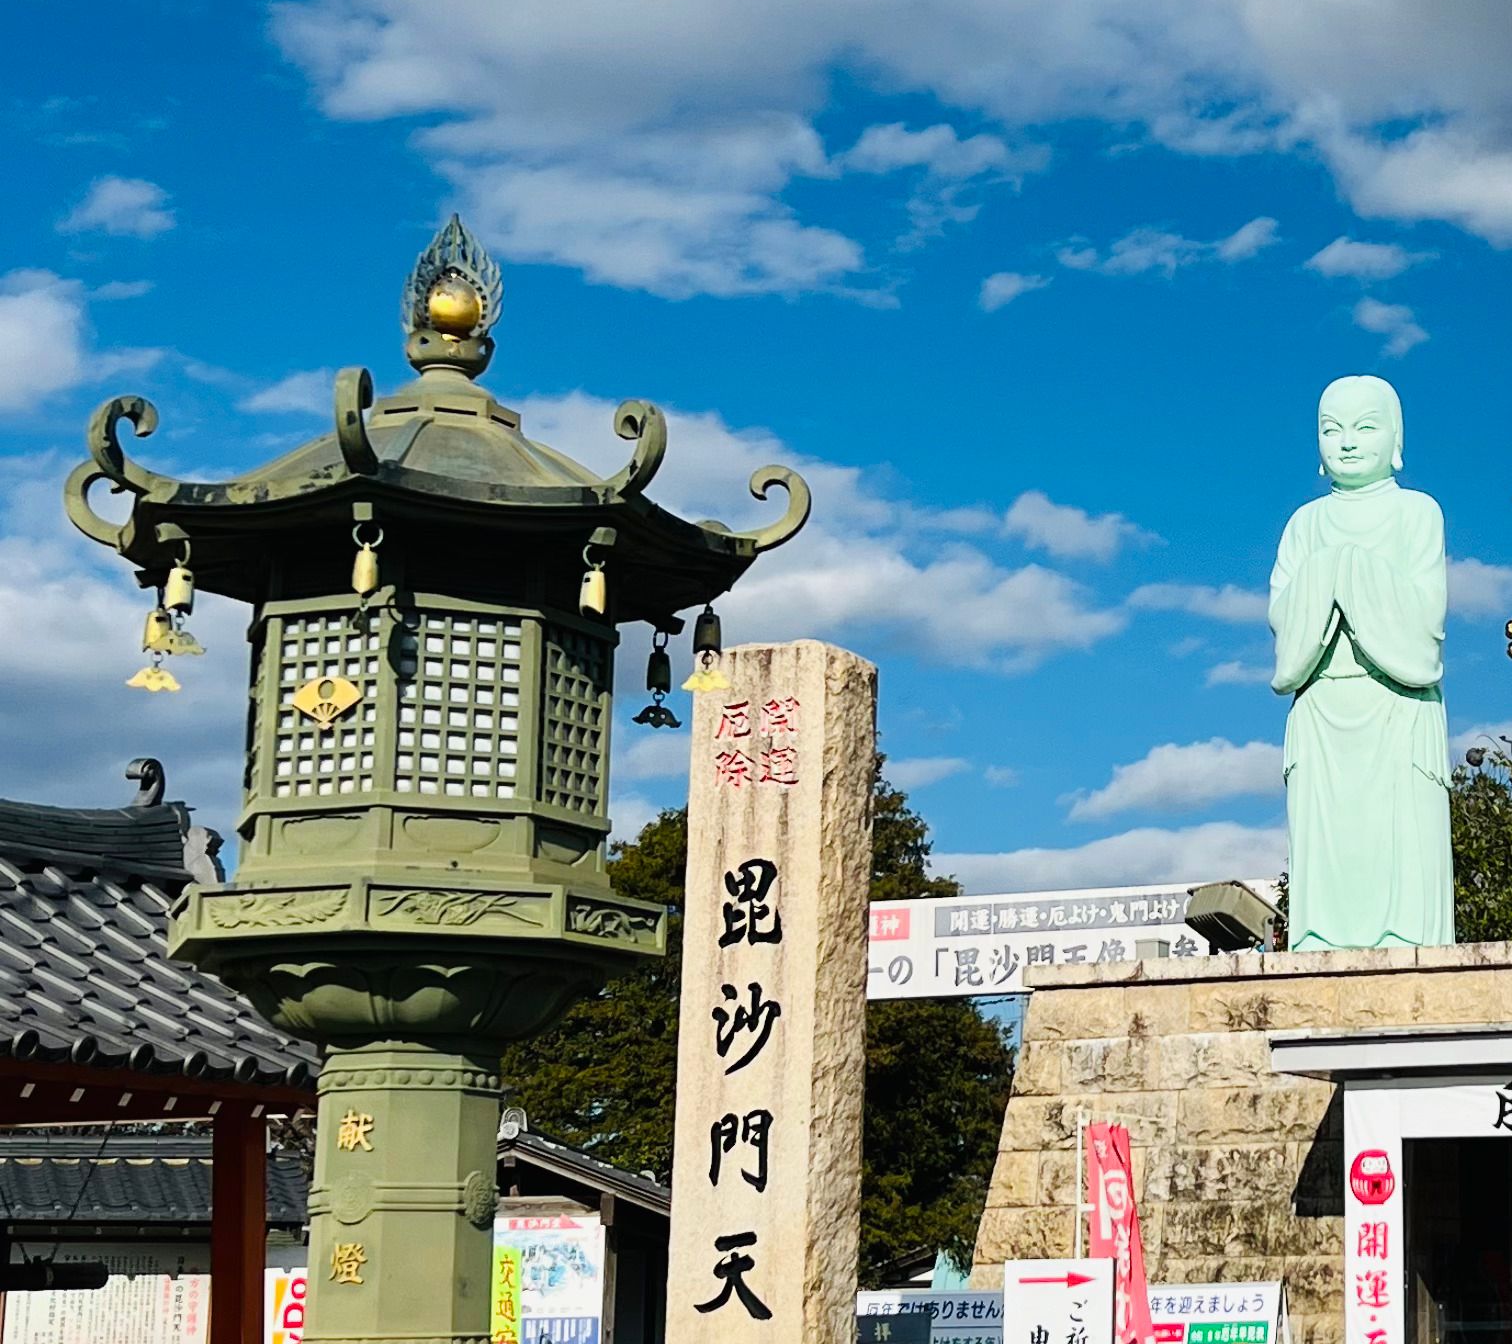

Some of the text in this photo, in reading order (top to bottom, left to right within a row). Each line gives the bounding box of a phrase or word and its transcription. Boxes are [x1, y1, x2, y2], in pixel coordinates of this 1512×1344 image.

[714, 700, 756, 788] 厄除
[693, 858, 783, 1321] 毘沙門天
[328, 1109, 374, 1285] 献燈
